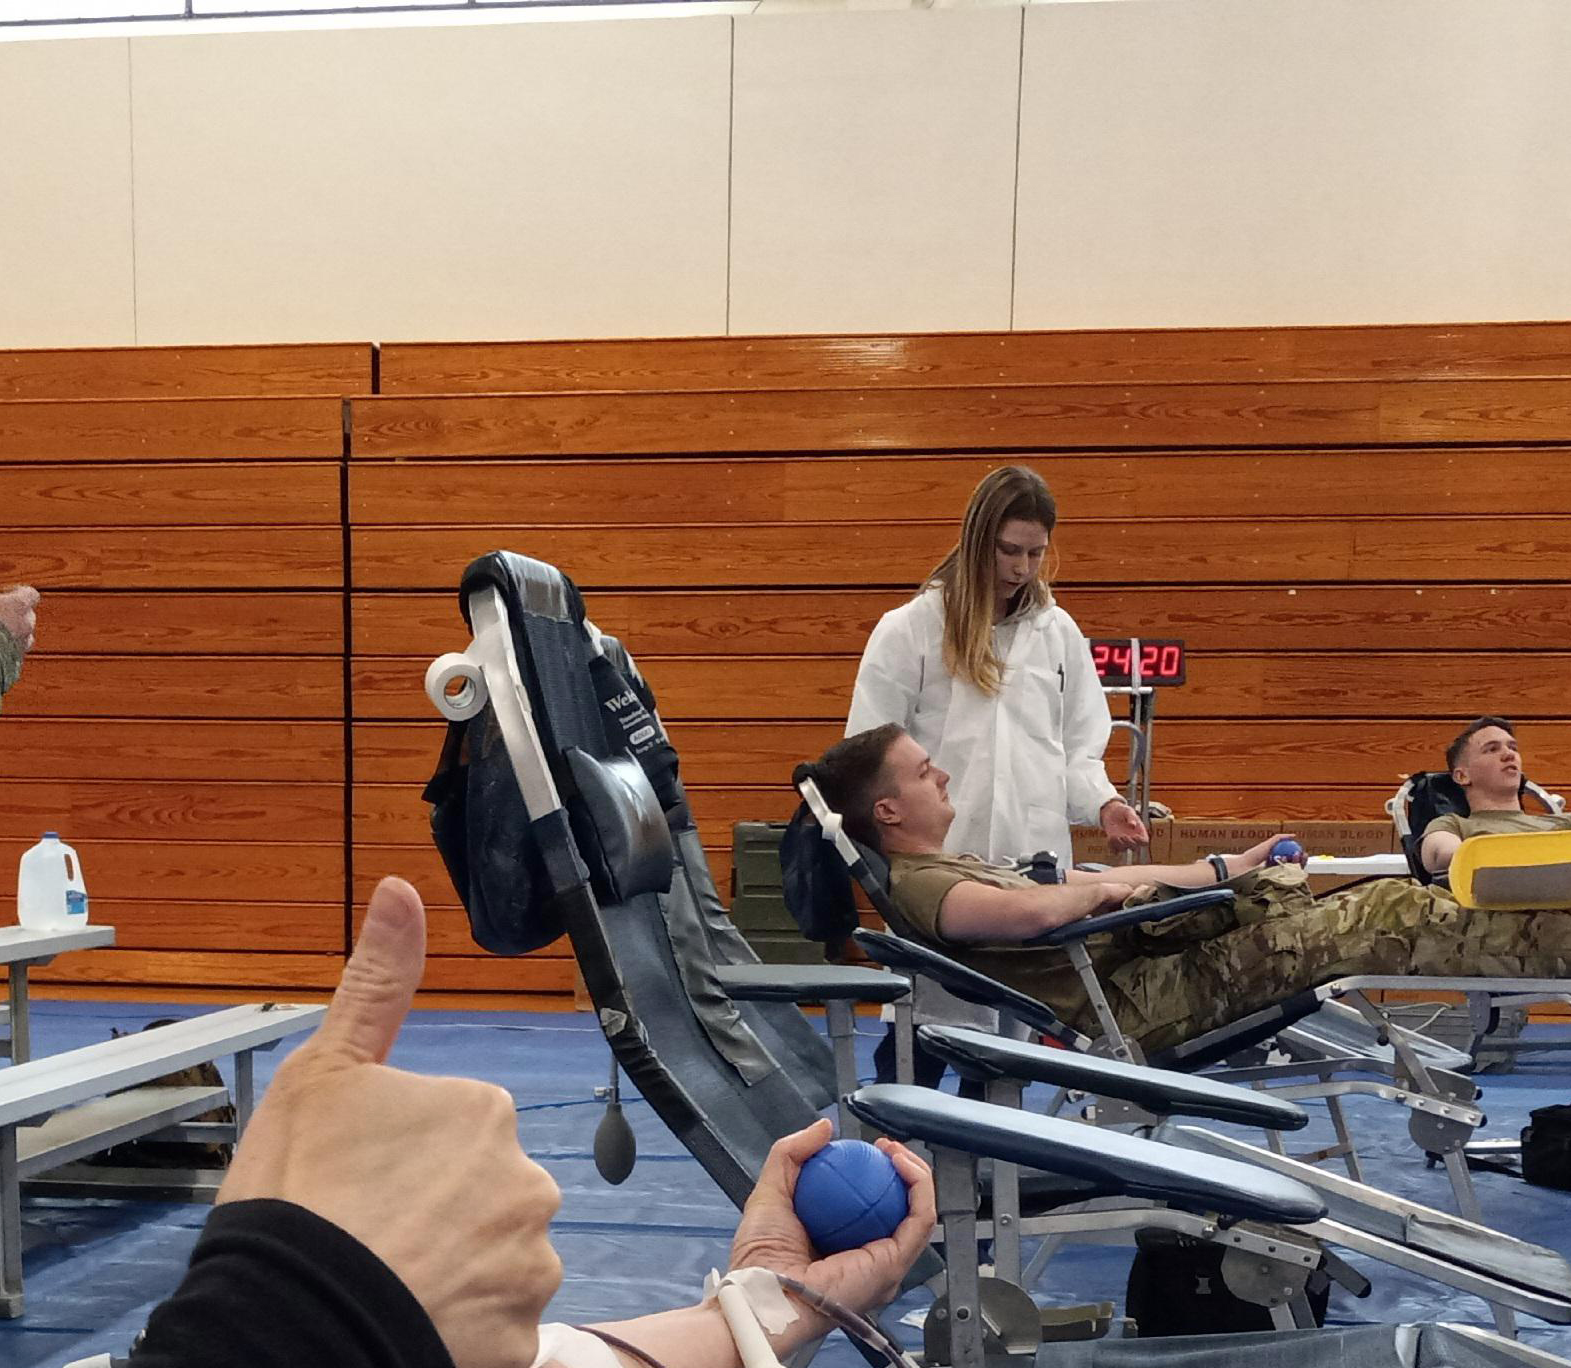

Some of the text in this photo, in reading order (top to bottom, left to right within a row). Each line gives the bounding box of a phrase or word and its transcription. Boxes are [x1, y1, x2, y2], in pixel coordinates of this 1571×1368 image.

[1180, 829, 1276, 839] HUMAN BLOOD
[1339, 829, 1384, 839] BLOOD
